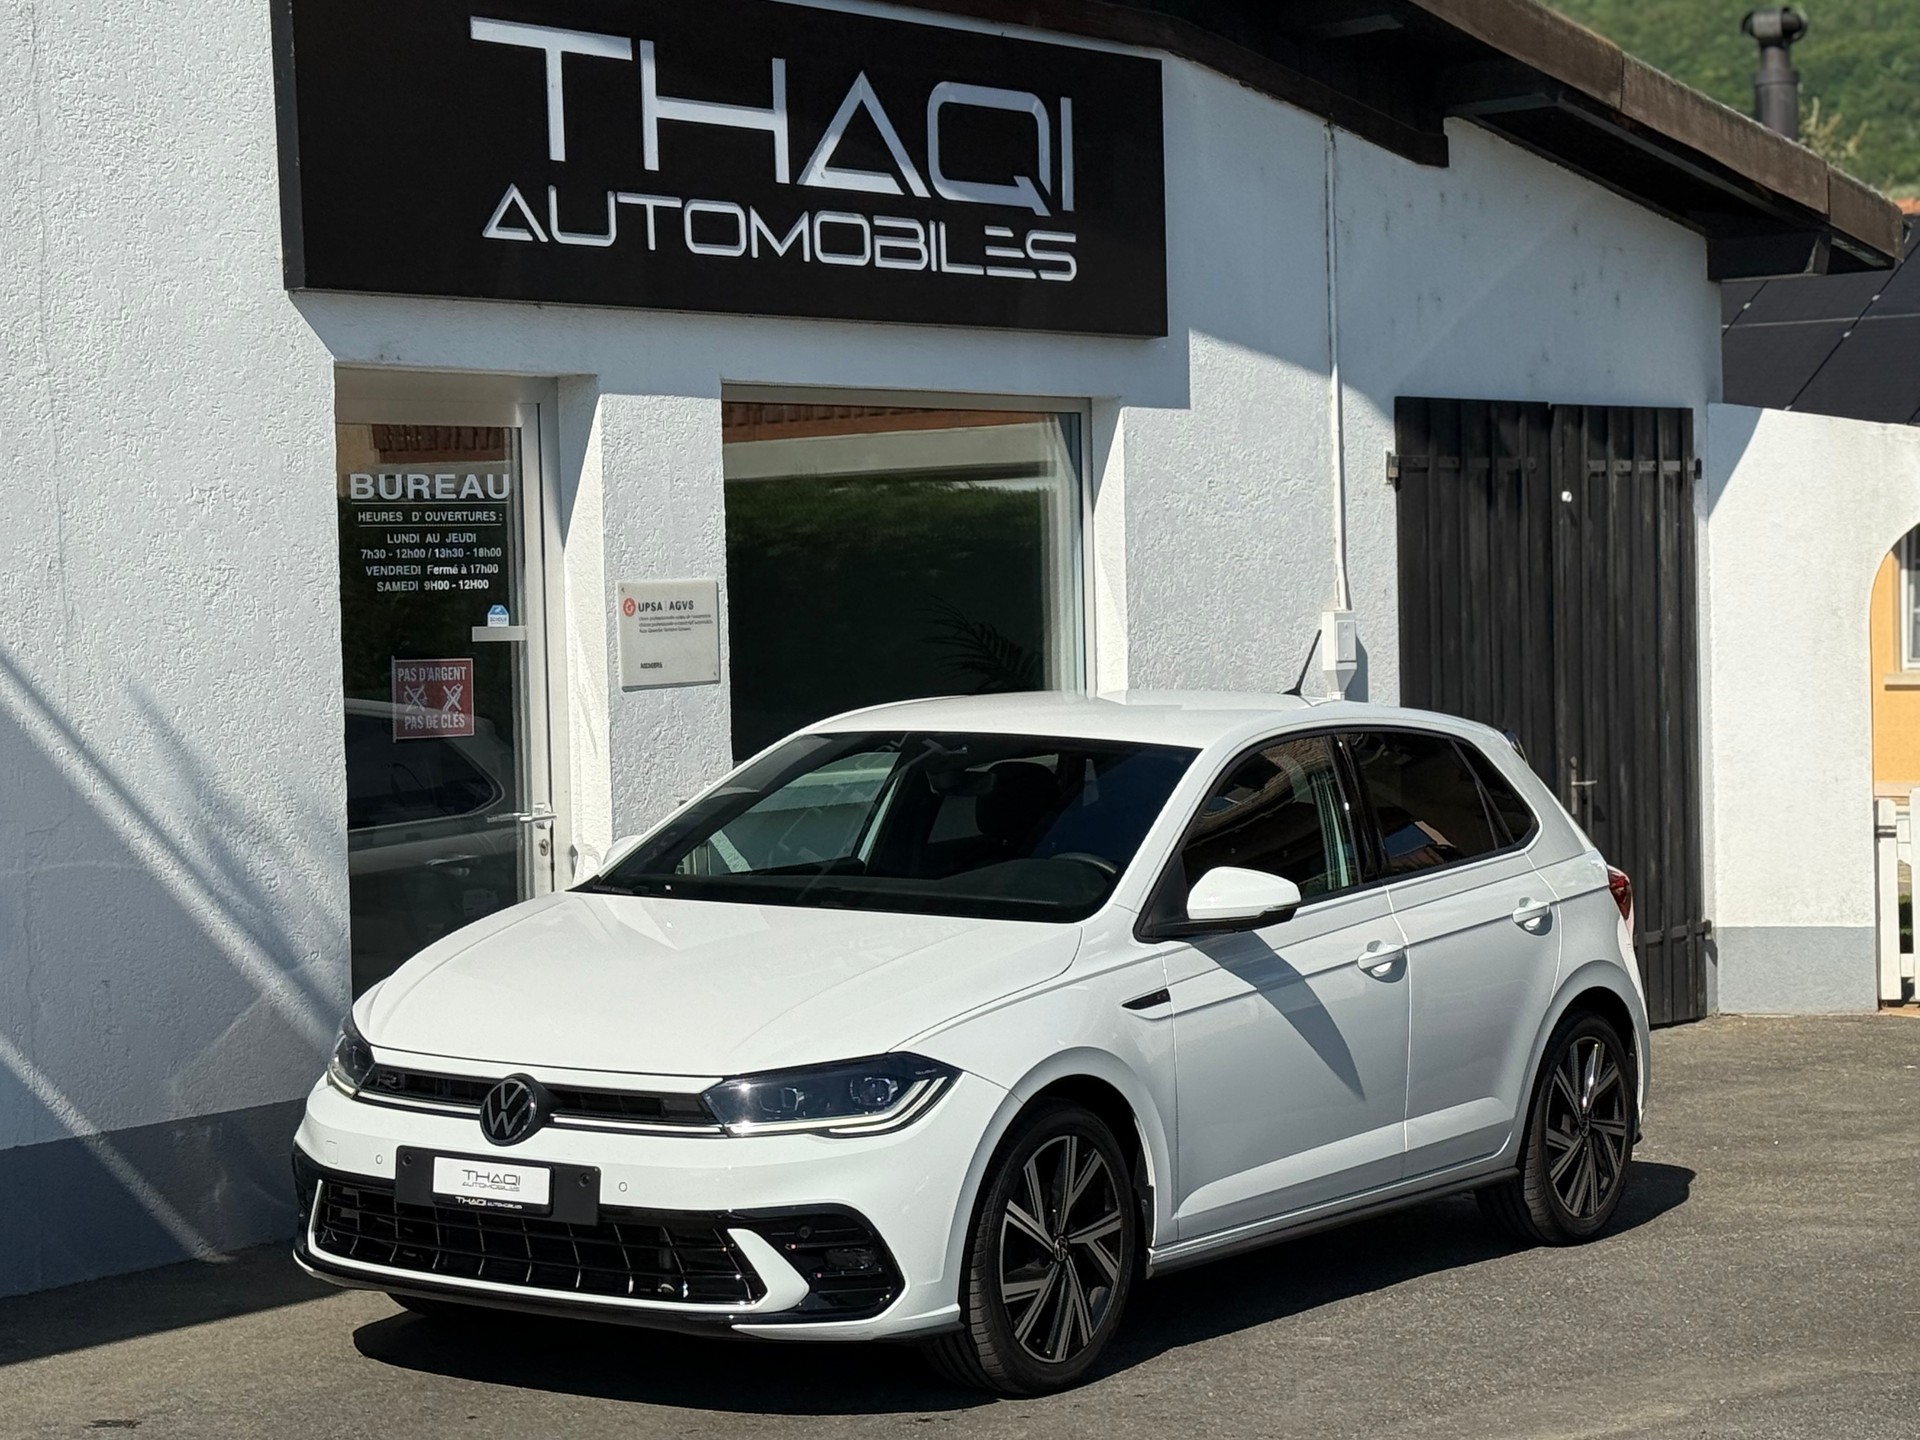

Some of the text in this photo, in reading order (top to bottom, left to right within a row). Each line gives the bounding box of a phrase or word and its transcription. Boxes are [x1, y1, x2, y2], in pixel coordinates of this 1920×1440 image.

[470, 16, 1075, 217] THAQI
[482, 183, 1077, 283] AUTOMOBILES
[350, 473, 510, 500] BUREAU
[358, 511, 403, 522] HEURES
[387, 532, 477, 544] LUNDI AU JEUDI
[360, 549, 386, 559] 7h30
[396, 548, 426, 559] 12h00
[434, 548, 464, 559] 13h30
[473, 547, 502, 558] 18h00
[365, 563, 499, 576] VENDREDI Fermé à 17h00
[376, 581, 419, 592] SAMEDI
[424, 580, 450, 591] 9H00
[458, 579, 489, 590] 12H00
[638, 600, 694, 612] UPSA AGVS
[397, 666, 467, 682] PAS D'ARGENT
[404, 711, 466, 730] PAS DE CLÉS
[461, 1169, 521, 1186] THAQI
[455, 1196, 487, 1207] THAQI
